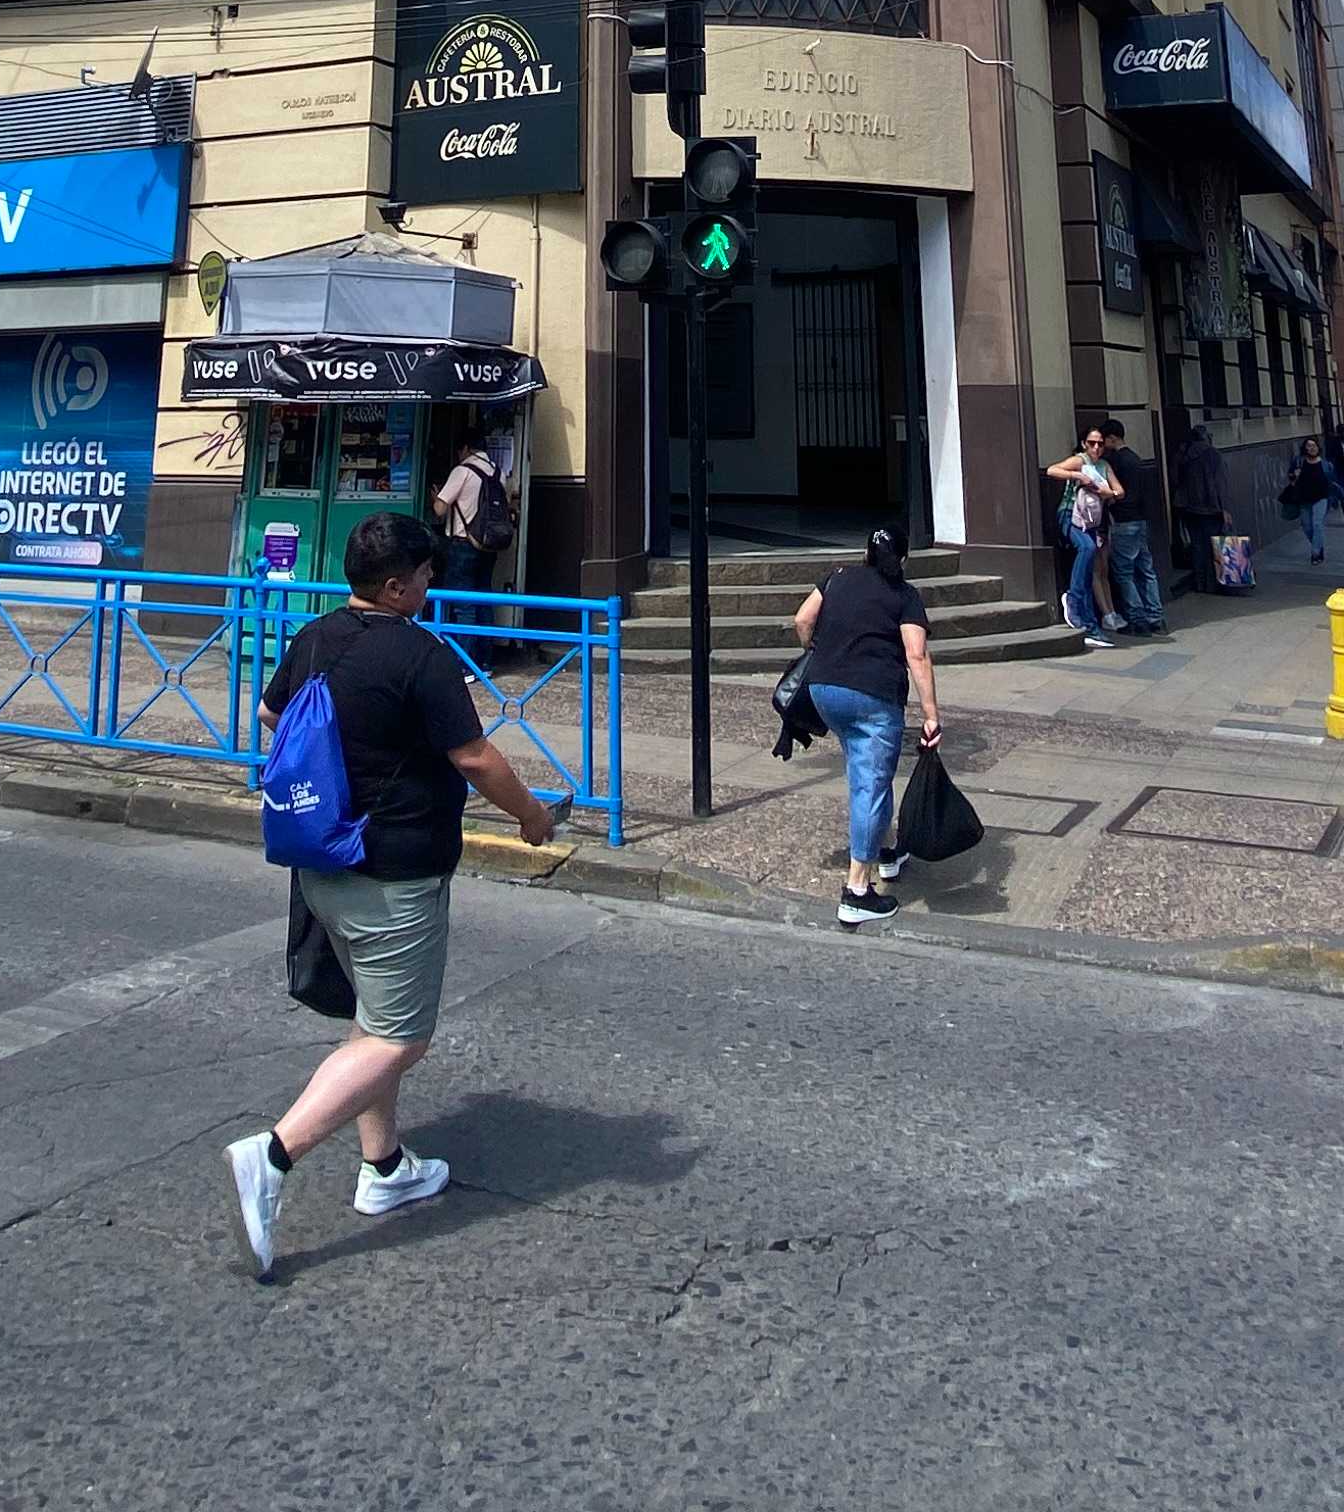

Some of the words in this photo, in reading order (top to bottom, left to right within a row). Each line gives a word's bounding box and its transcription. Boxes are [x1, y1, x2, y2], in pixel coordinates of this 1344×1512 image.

[437, 29, 477, 73] CAFETERÍA
[489, 27, 528, 64] RESTOBAR
[404, 64, 562, 109] AUSTRAL
[763, 69, 859, 96] EDIFICIO
[722, 107, 796, 131] DIARIO
[804, 111, 897, 138] AUSTRAL
[22, 437, 81, 465] LLEGÓ
[84, 441, 108, 465] EL
[98, 471, 127, 496] DE
[15, 544, 62, 558] CONTRATA
[63, 548, 97, 561] AHORA
[290, 780, 313, 793] CAJA
[292, 789, 310, 800] LOS
[293, 795, 320, 809] ANDES
